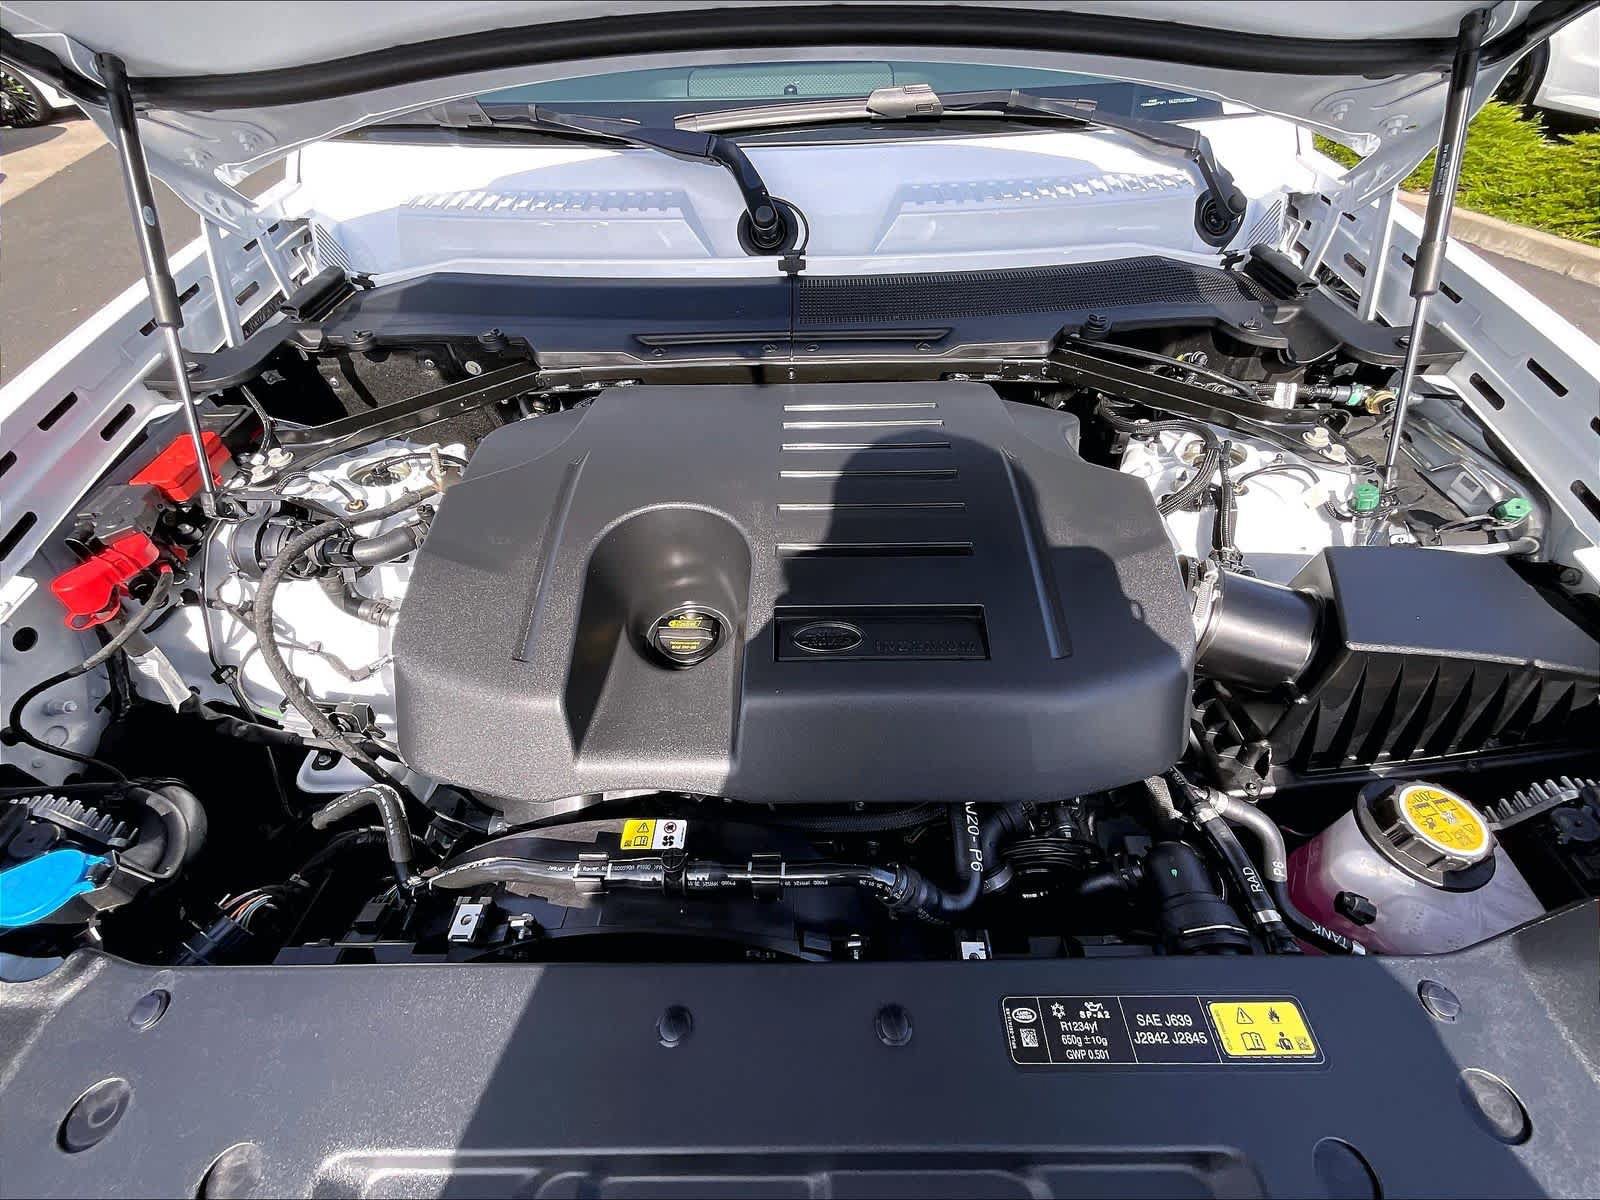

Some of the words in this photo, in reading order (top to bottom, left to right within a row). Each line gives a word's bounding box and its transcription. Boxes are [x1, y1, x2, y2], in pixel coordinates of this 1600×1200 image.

[1242, 866, 1264, 893] RAD
[1311, 921, 1348, 950] TANK
[1136, 1013, 1163, 1027] SAE
[1164, 1013, 1193, 1027] J639
[1060, 1021, 1098, 1034] R1234yf
[1061, 1034, 1083, 1047] 650g
[1134, 1031, 1170, 1045] J2842
[1171, 1031, 1208, 1045] J2845
[1066, 1049, 1086, 1060] GWP
[1087, 1049, 1110, 1060] 0.501
